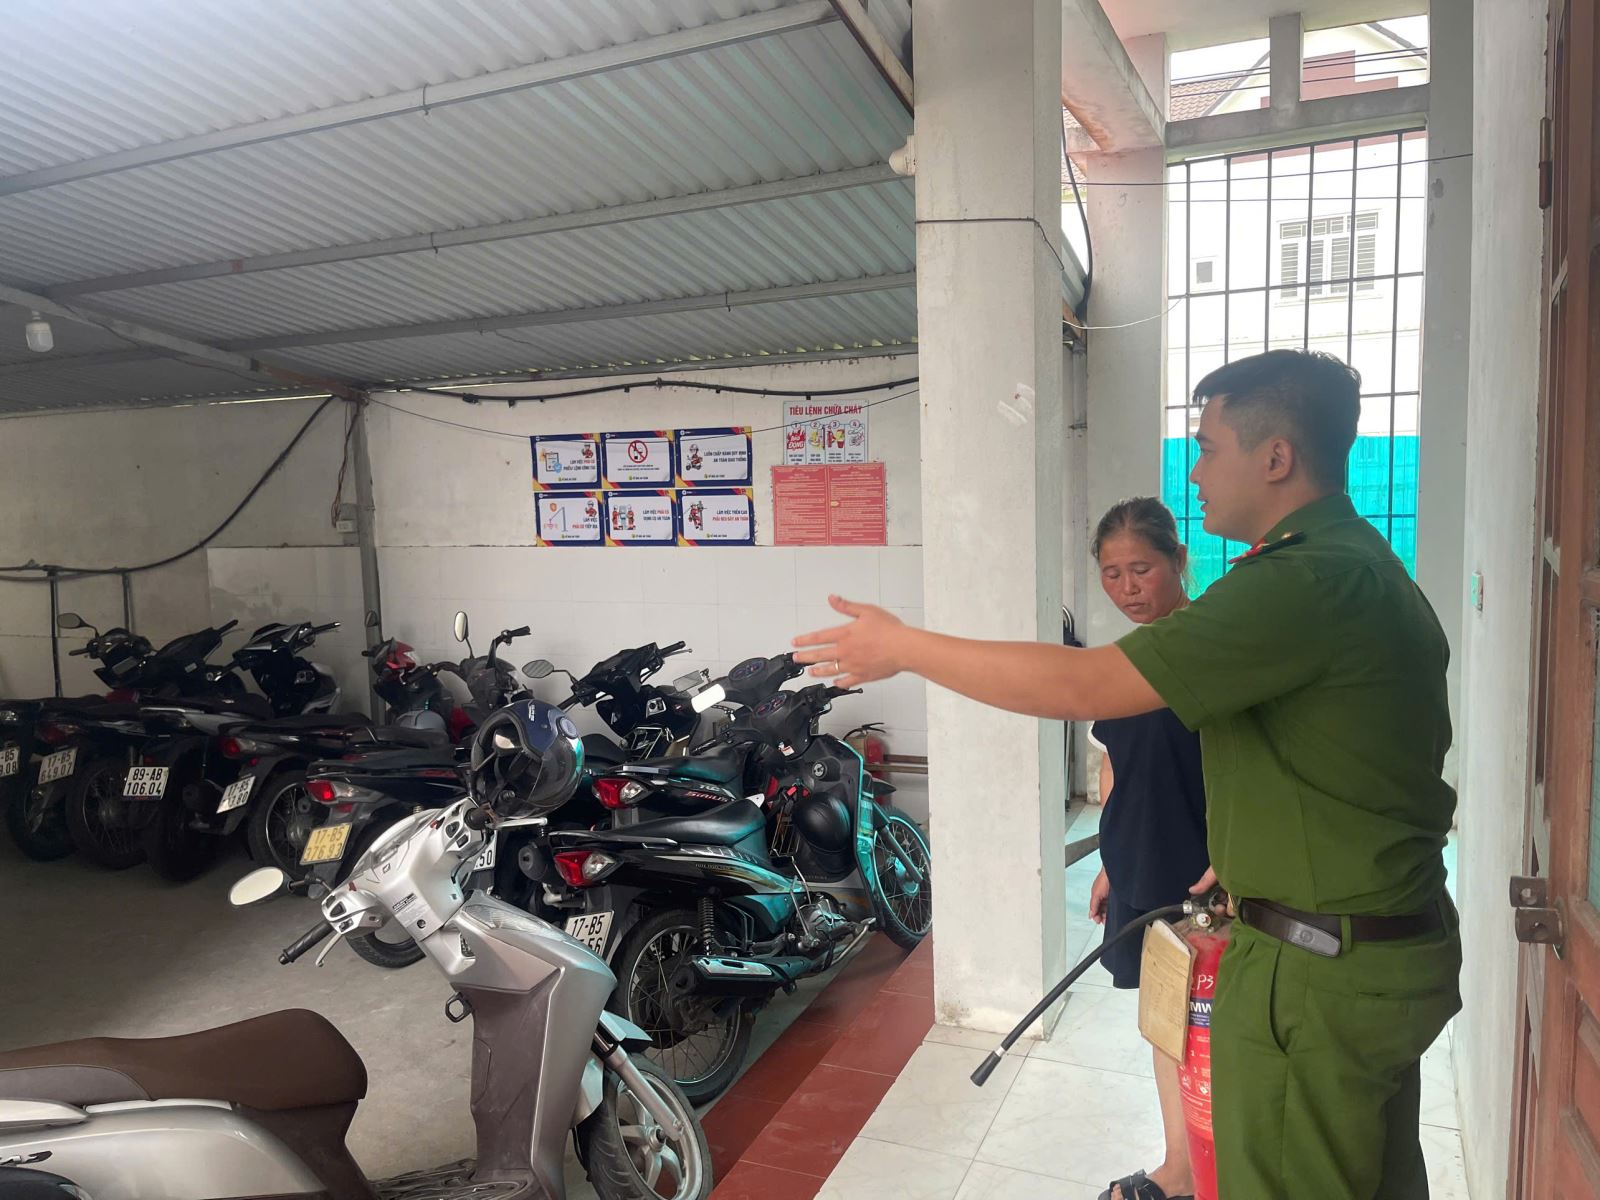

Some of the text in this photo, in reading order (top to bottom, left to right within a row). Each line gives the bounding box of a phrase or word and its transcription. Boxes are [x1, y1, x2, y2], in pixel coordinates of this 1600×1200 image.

[132, 768, 163, 781] 89-AB
[127, 782, 162, 796] 106.04
[315, 826, 345, 844] 17-B5
[572, 915, 606, 938] 17-B5
